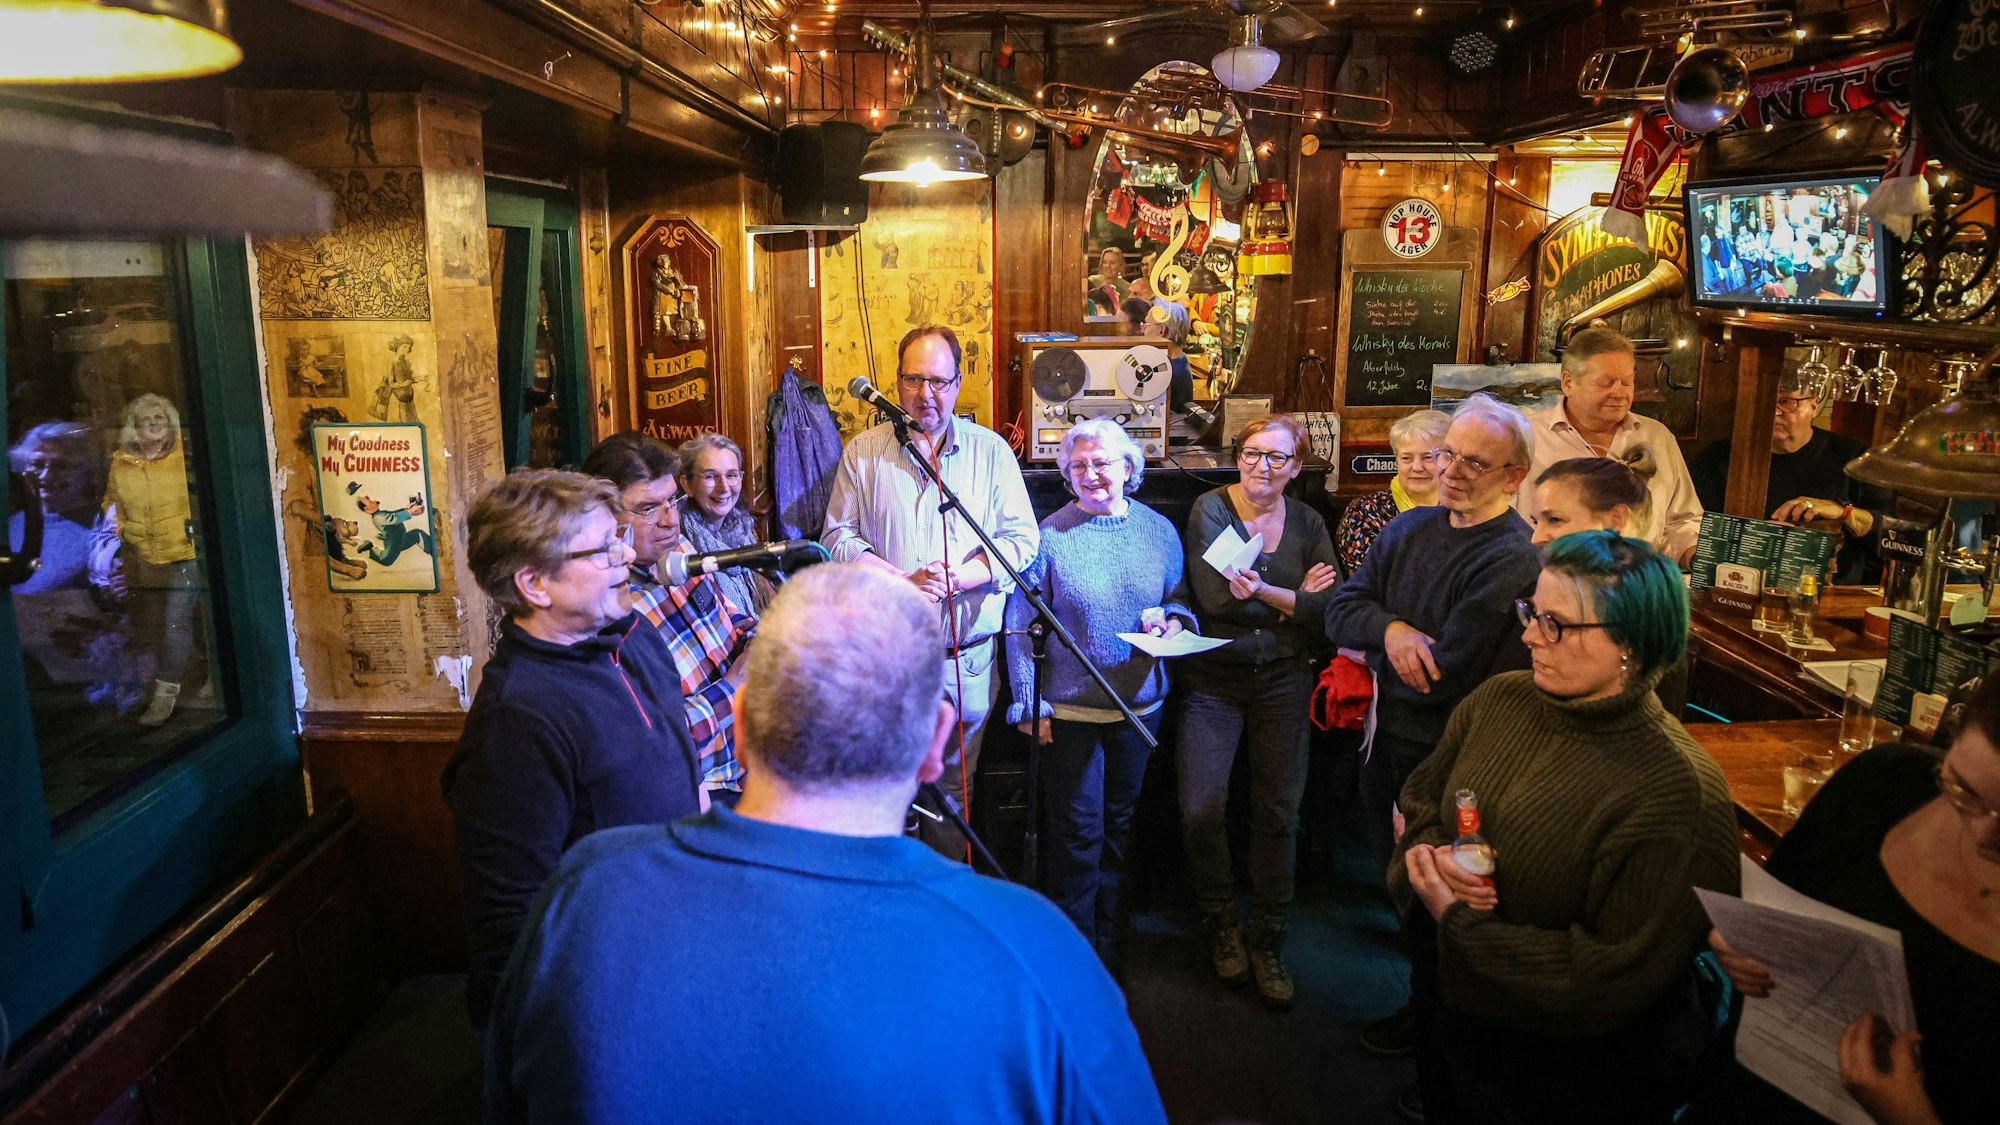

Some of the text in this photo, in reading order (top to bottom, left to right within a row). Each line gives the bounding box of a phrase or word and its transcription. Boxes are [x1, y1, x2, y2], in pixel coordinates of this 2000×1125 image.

[1388, 204, 1437, 229] HOP HOUSE
[1395, 217, 1430, 243] 13
[1394, 242, 1428, 254] LAGER
[1355, 277, 1393, 295] Whisky
[1352, 333, 1395, 356] Whisky
[1398, 335, 1415, 350] des
[654, 355, 692, 375] FINE
[656, 382, 698, 406] BEER
[1367, 380, 1377, 391] 12
[327, 434, 411, 455] My Goodness
[321, 453, 421, 477] My GUINNESS
[1881, 537, 1924, 557] GUINNESS
[1718, 596, 1752, 610] GUINNESS
